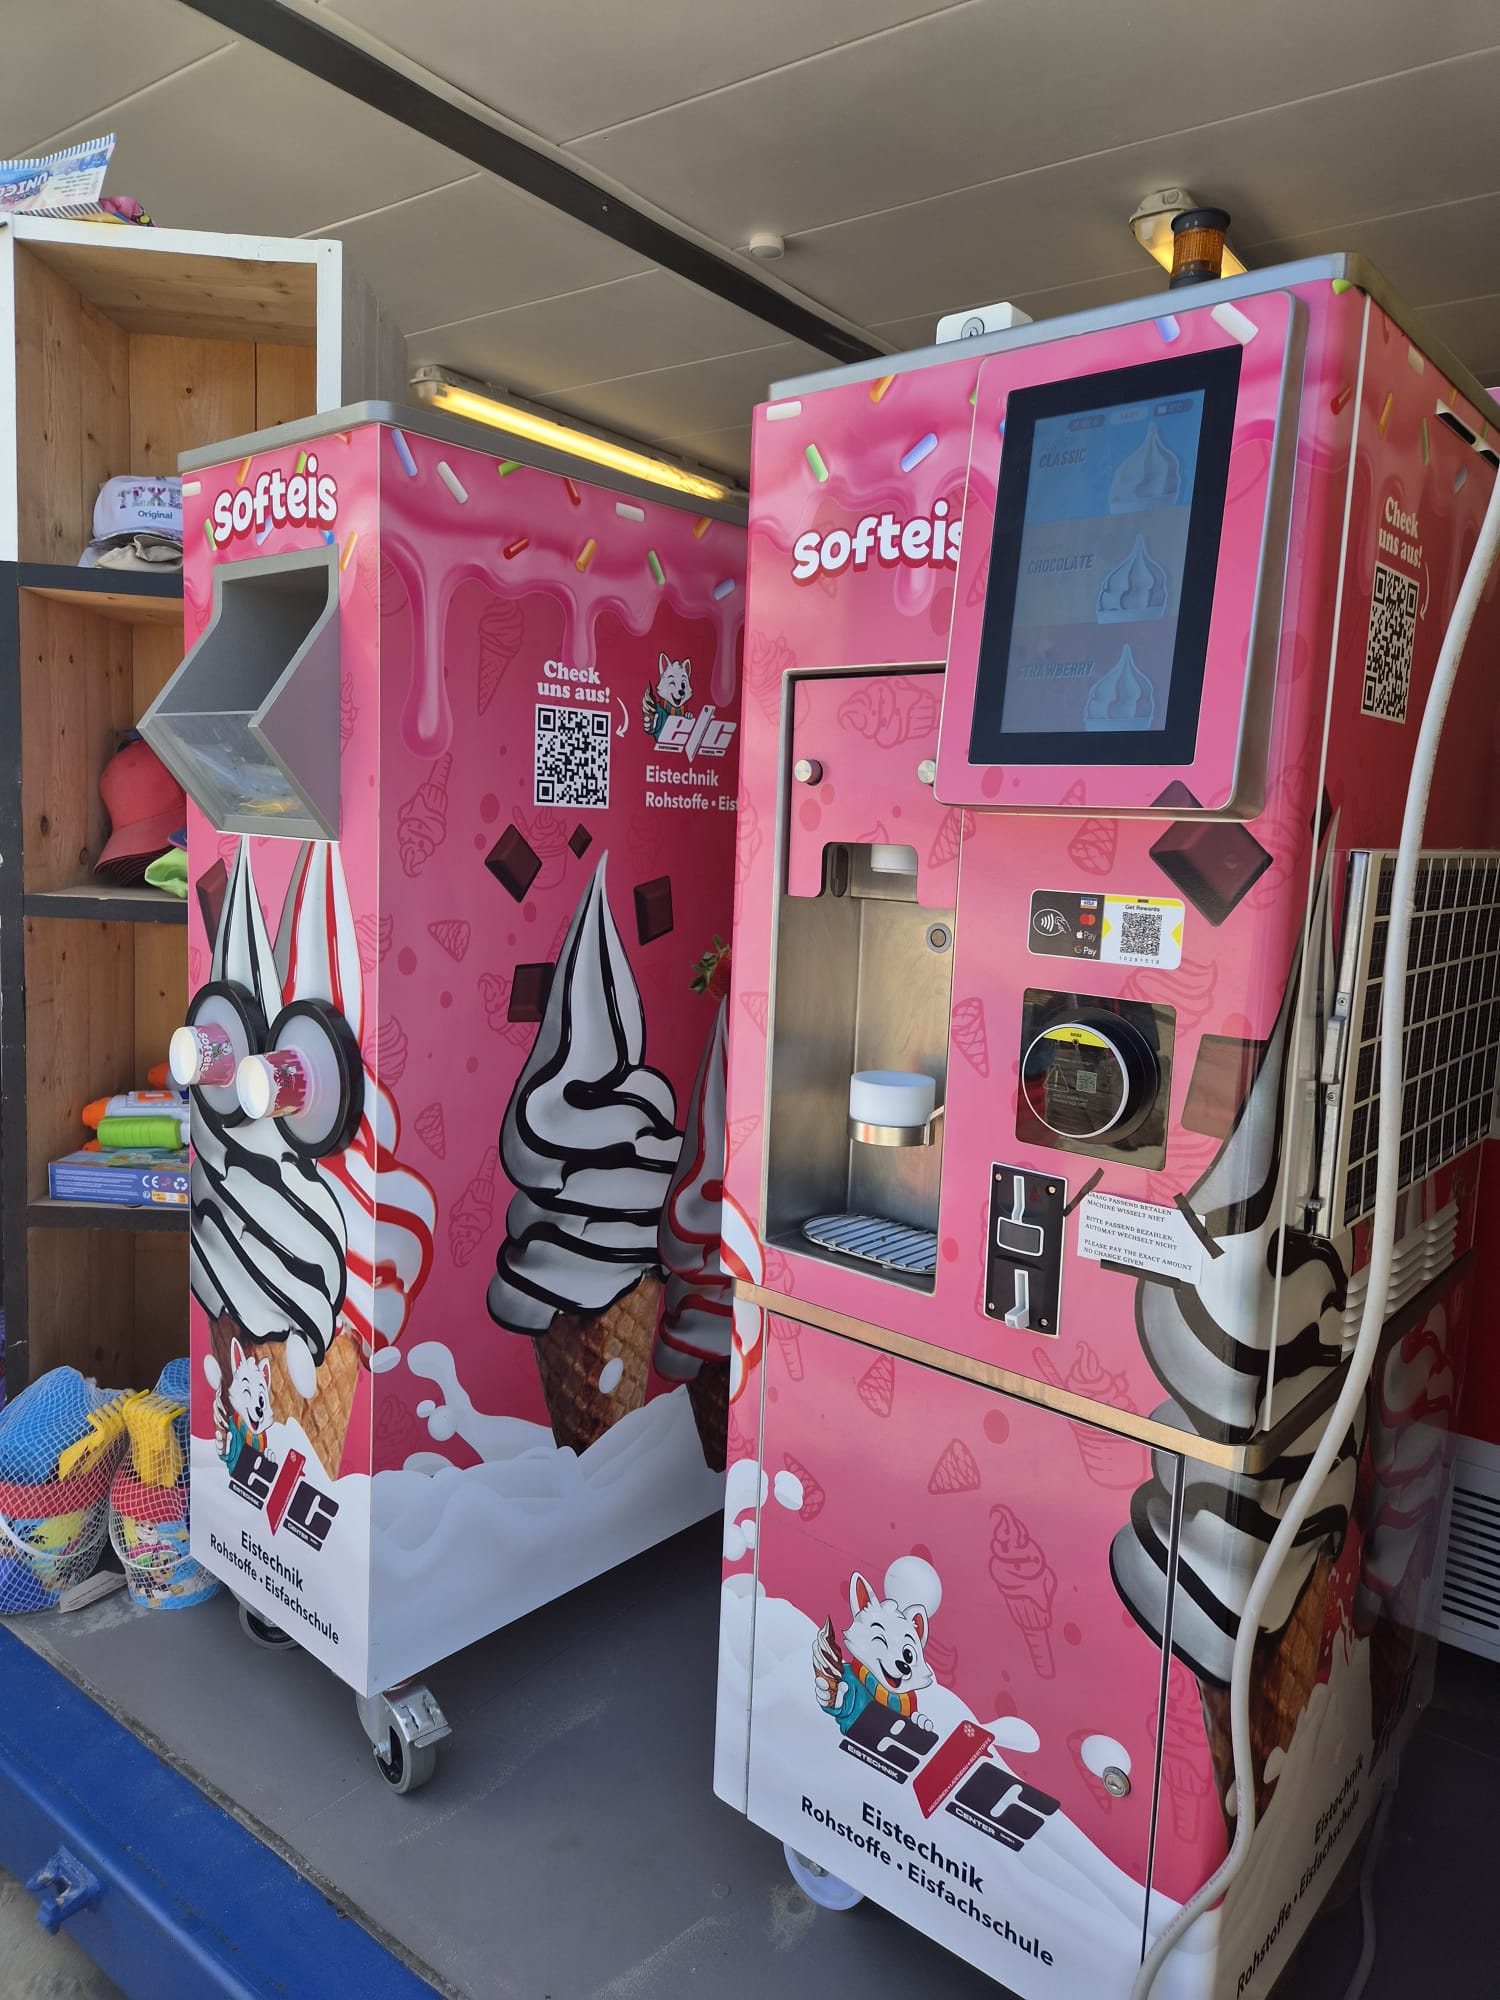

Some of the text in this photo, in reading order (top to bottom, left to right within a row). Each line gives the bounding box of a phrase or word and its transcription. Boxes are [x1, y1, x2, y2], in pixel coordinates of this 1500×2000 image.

[1038, 447, 1087, 469] CLASSIC
[213, 455, 337, 545] softeis
[137, 509, 173, 521] Original
[1385, 496, 1418, 539] Check
[1378, 528, 1423, 569] uns aus!
[1026, 554, 1095, 576] CHOCOLATE
[543, 659, 601, 684] Check
[1016, 660, 1095, 680] STRAWBERRY
[537, 681, 611, 704] uns aus!
[645, 765, 719, 787] Eistechnik
[645, 791, 709, 810] Rohstoffe
[1084, 931, 1097, 942] Pay
[1083, 946, 1097, 957] Pay
[1087, 1199, 1165, 1223] MACHINE WISSELT NIET
[1108, 1197, 1139, 1209] PASSEND
[1139, 1204, 1172, 1216] BETALEN
[1086, 1215, 1104, 1225] BITTE
[1104, 1219, 1135, 1232] PASSEND
[1085, 1223, 1178, 1251] AUTOMAT WECHSELT NICHT
[1084, 1239, 1193, 1271] PLEASE PAY THE EXACT AMOUNT
[1084, 1247, 1144, 1267] NO CHANGE GIVEN
[241, 1530, 304, 1592] Eistechnik
[210, 1533, 340, 1645] Rohstoffe Eisfachschule
[847, 1744, 900, 1780] EISTECHNIK
[1314, 1751, 1363, 1846] Eistechnik
[955, 1806, 996, 1836] CENTER
[862, 1801, 984, 1894] Eistechnik
[801, 1795, 1054, 1967] Rohstoffe Eisfachschule
[1236, 1788, 1360, 2000] Rohstoffe Eisfachschule
